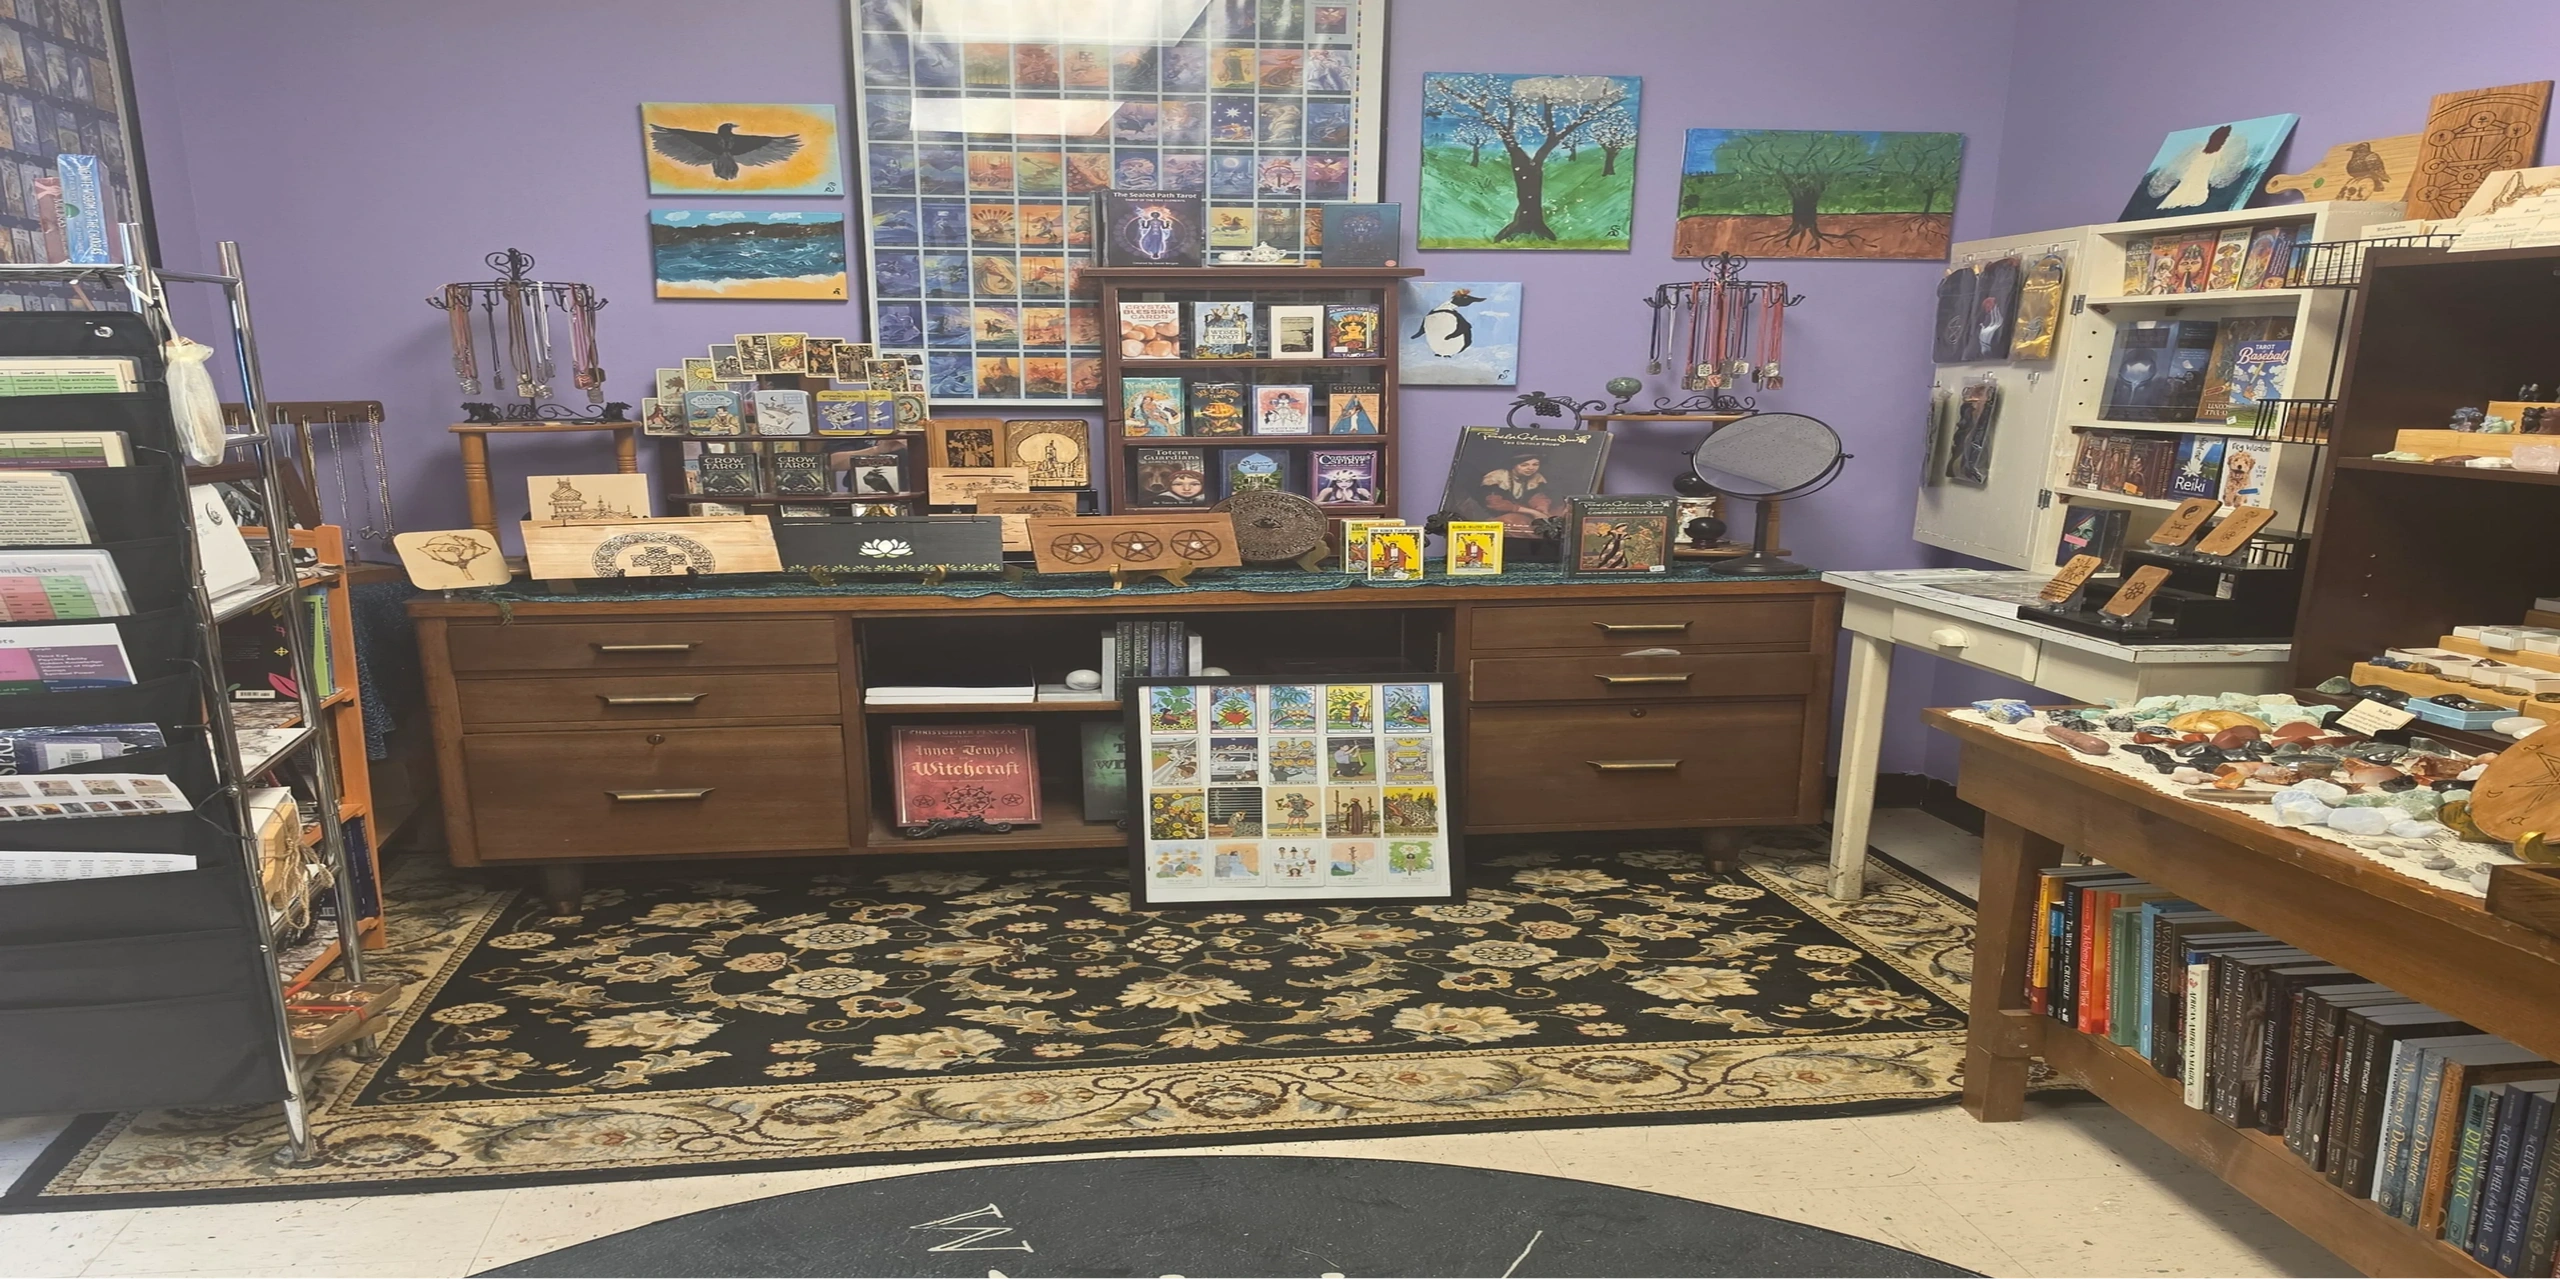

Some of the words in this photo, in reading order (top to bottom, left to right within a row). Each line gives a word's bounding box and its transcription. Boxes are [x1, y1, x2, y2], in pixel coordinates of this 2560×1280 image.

[86, 218, 99, 228] THE
[2237, 347, 2290, 364] Baseball
[2175, 477, 2207, 493] Reiki
[916, 745, 956, 756] Inner
[962, 744, 1016, 758] Temple
[911, 760, 1020, 778] Witchcraft
[2082, 924, 2090, 933] The
[2080, 935, 2090, 962] Alchemy
[2142, 938, 2150, 973] Reluctant
[2152, 920, 2162, 990] WANDLORE
[2158, 925, 2172, 997] WANDLORE
[2062, 964, 2070, 1000] CRUCIBLE
[2080, 969, 2089, 987] Inner
[2223, 960, 2233, 984] STICKS
[2236, 966, 2245, 991] STICKS
[2141, 975, 2150, 1005] Empath
[2222, 985, 2232, 1011] STONES
[2188, 991, 2197, 1020] AFRICAN
[2234, 992, 2244, 1018] STONES
[2263, 1019, 2275, 1047] Entering
[2302, 996, 2315, 1051] CERRIDWEN
[2186, 1023, 2195, 1057] AMERICAN
[2346, 1025, 2355, 1050] MODERN
[2364, 1034, 2374, 1059] MODERN
[2263, 1048, 2273, 1073] Hekate's
[2341, 1050, 2352, 1083] WITCHCRAFT
[2260, 1074, 2271, 1102] Cauldron
[2359, 1060, 2371, 1093] WITCHCRAFT
[2393, 1058, 2417, 1111] Mysteries
[2337, 1092, 2346, 1115] GREEK
[2415, 1068, 2440, 1121] Mysteries
[2355, 1102, 2365, 1125] GREEK
[2392, 1114, 2408, 1129] of
[2414, 1123, 2431, 1138] of
[2460, 1127, 2482, 1161] REAL
[2384, 1129, 2405, 1175] Demeter
[2406, 1138, 2428, 1185] Demeter
[2494, 1133, 2511, 1163] CELTIC
[2519, 1144, 2537, 1174] CELTIC
[2428, 1157, 2442, 1190] GODDESS
[2451, 1161, 2476, 1206] MAGIC
[2489, 1164, 2505, 1193] WHEEL
[2543, 1177, 2557, 1190] &
[2514, 1176, 2530, 1203] WHEEL
[2481, 1207, 2496, 1232] YEAR
[2531, 1191, 2555, 1240] MAGICK
[2505, 1218, 2520, 1243] YEAR
